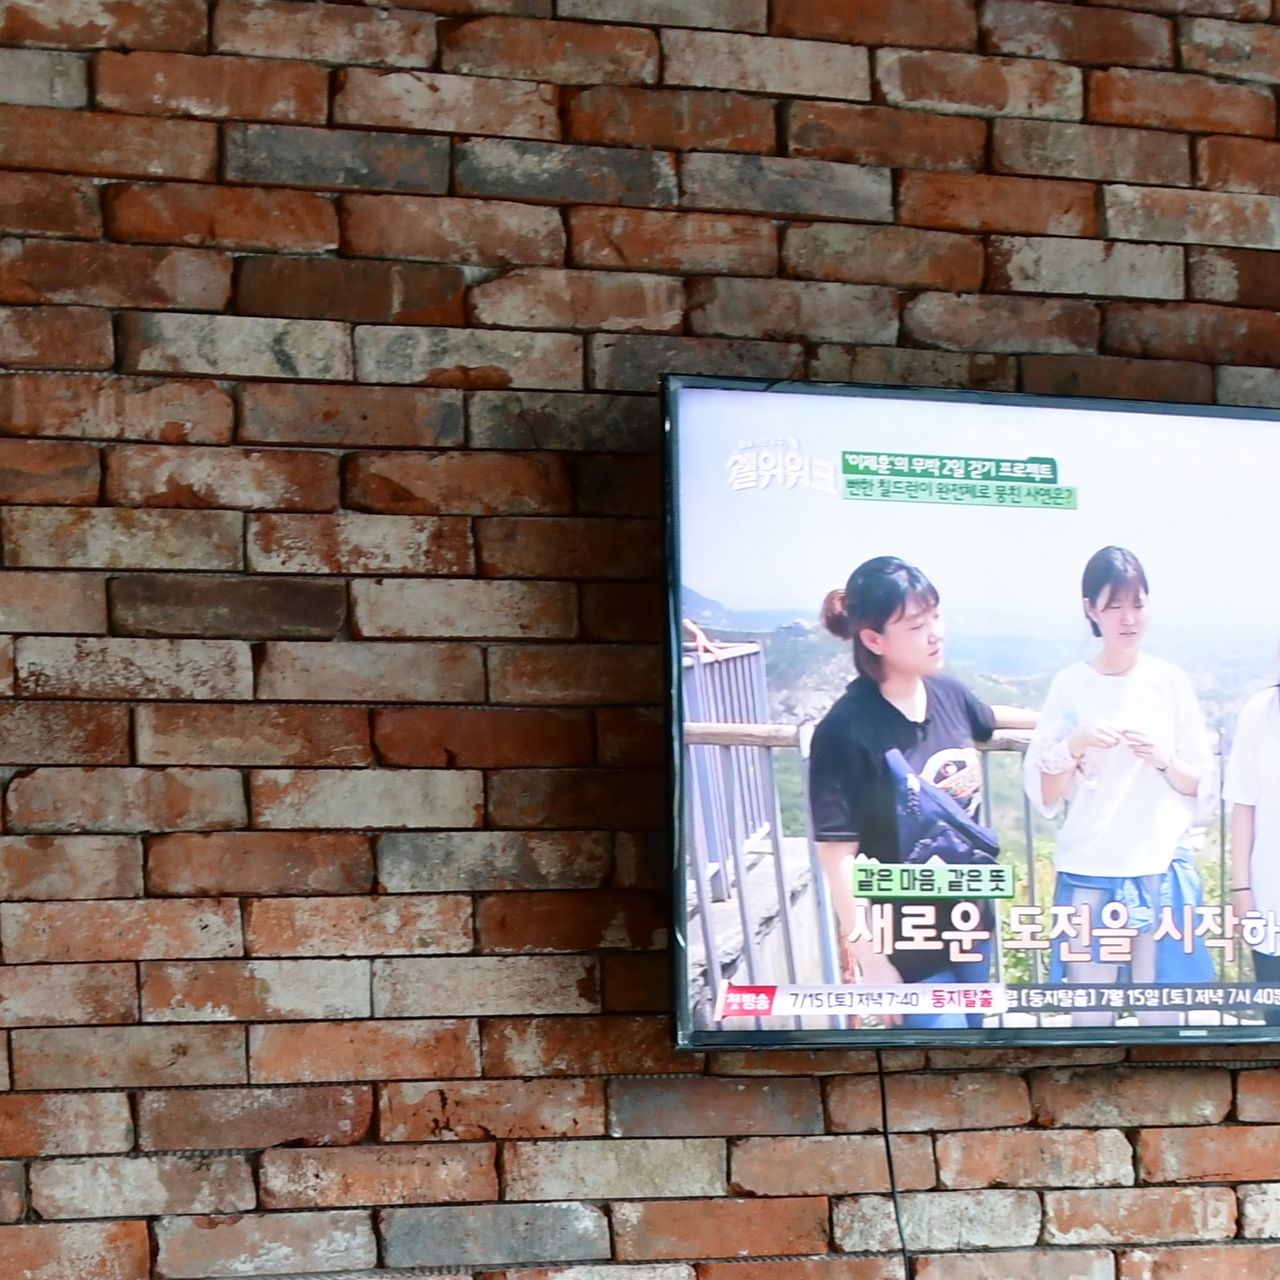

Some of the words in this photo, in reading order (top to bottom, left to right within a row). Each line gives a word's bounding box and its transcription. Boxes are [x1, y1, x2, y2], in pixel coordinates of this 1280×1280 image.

[942, 459, 966, 479] 2일
[968, 460, 997, 480] 걷기
[994, 485, 1021, 504] 뭉친
[857, 868, 894, 892] 같은
[900, 868, 942, 894] 마음,
[948, 868, 982, 892] 같은
[988, 868, 1006, 892] 뜻
[847, 901, 991, 963] 새로운
[1002, 901, 1139, 962] 도전을
[857, 991, 884, 1008] 저녁
[931, 989, 993, 1008] 둥지탈출
[1100, 988, 1124, 1007] 7월
[1127, 988, 1160, 1007] 15일
[1195, 988, 1223, 1006] 저녁
[1228, 987, 1251, 1005] 7시
